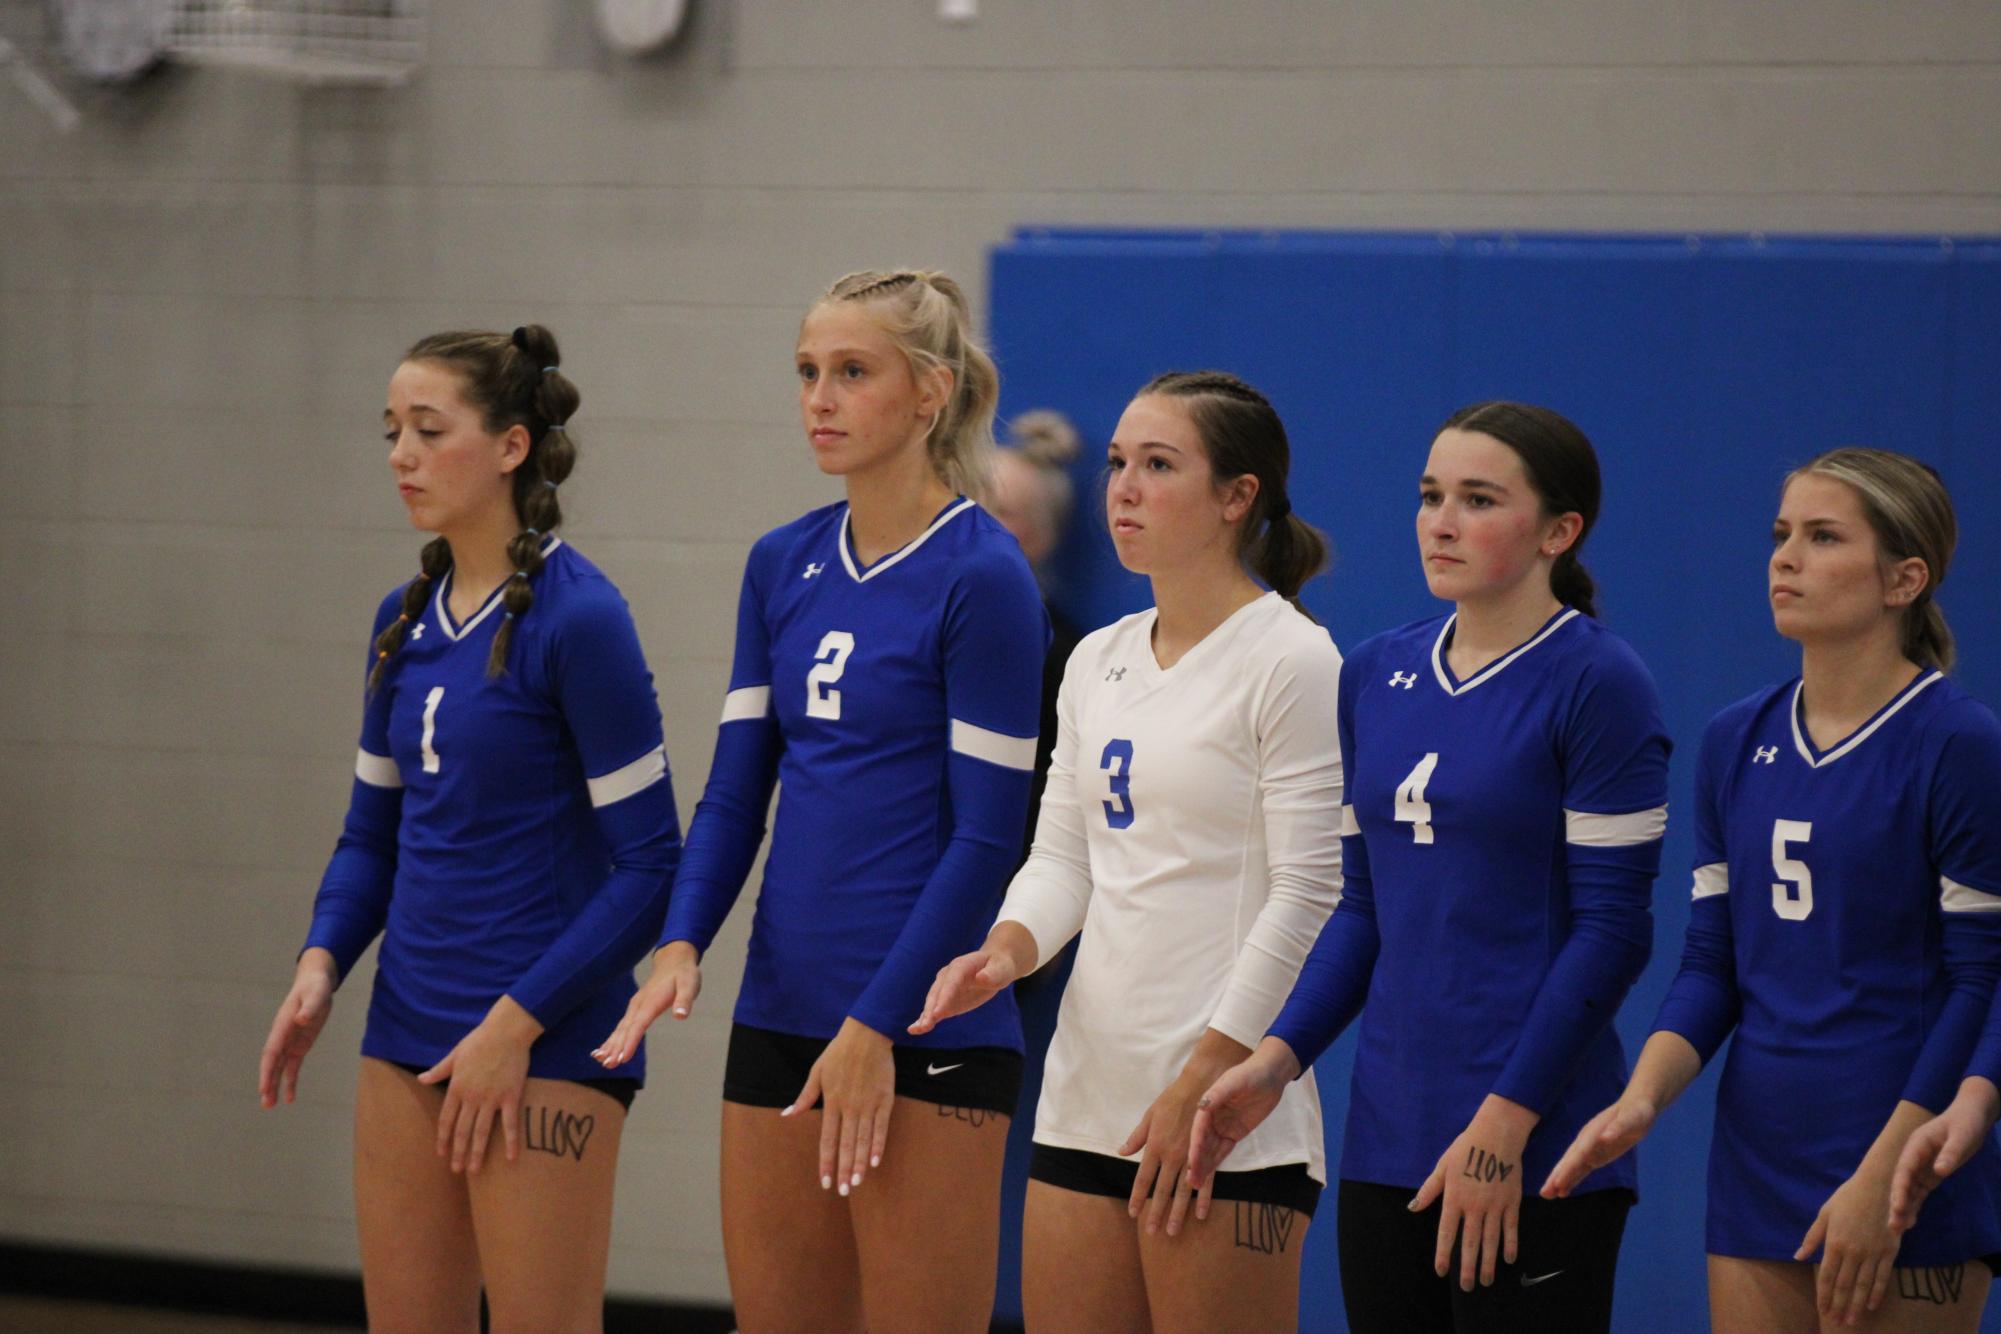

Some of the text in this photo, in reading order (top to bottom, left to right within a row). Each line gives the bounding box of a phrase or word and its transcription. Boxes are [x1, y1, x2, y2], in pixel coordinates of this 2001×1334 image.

[806, 631, 856, 721] 2
[421, 686, 445, 774] 1
[1100, 739, 1134, 830] 3
[1394, 752, 1439, 845] 4
[1772, 818, 1814, 921] 5
